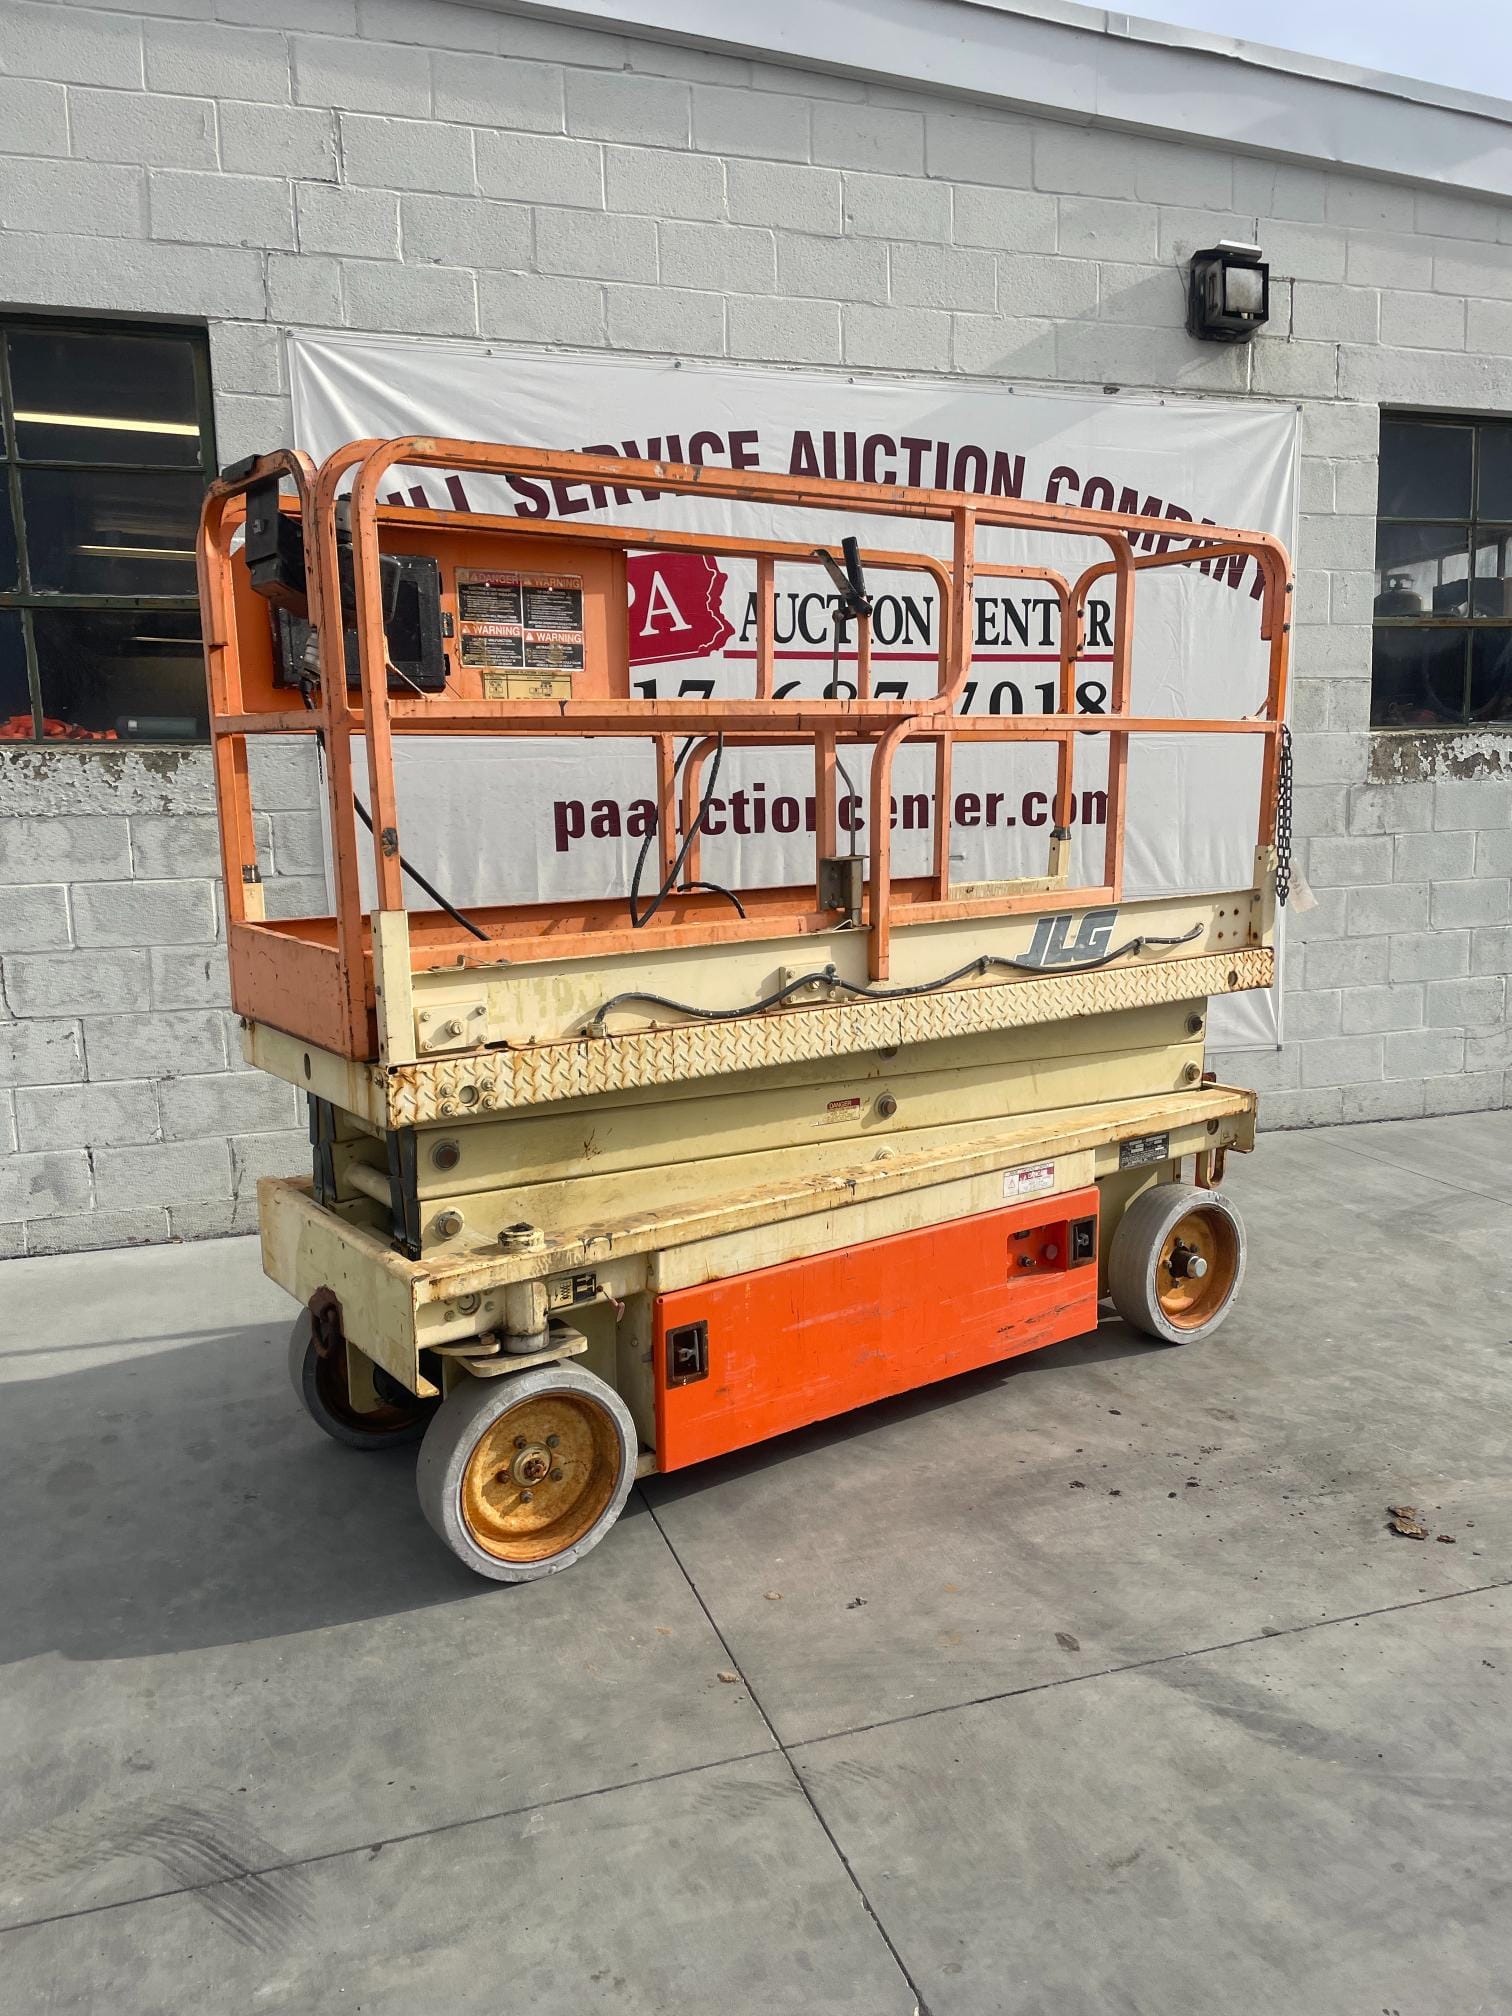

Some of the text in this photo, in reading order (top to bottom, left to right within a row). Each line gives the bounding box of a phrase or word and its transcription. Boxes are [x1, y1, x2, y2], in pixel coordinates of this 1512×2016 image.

[789, 430, 1026, 498] AUCTION
[535, 577, 580, 589] WARNING
[473, 625, 520, 636] WARNING
[739, 592, 1114, 647] AUCTON ENTR
[536, 632, 582, 643] WARNING
[553, 783, 1108, 852] paactiocner.cm
[1014, 908, 1120, 968] JLG
[829, 1100, 852, 1109] DANGER
